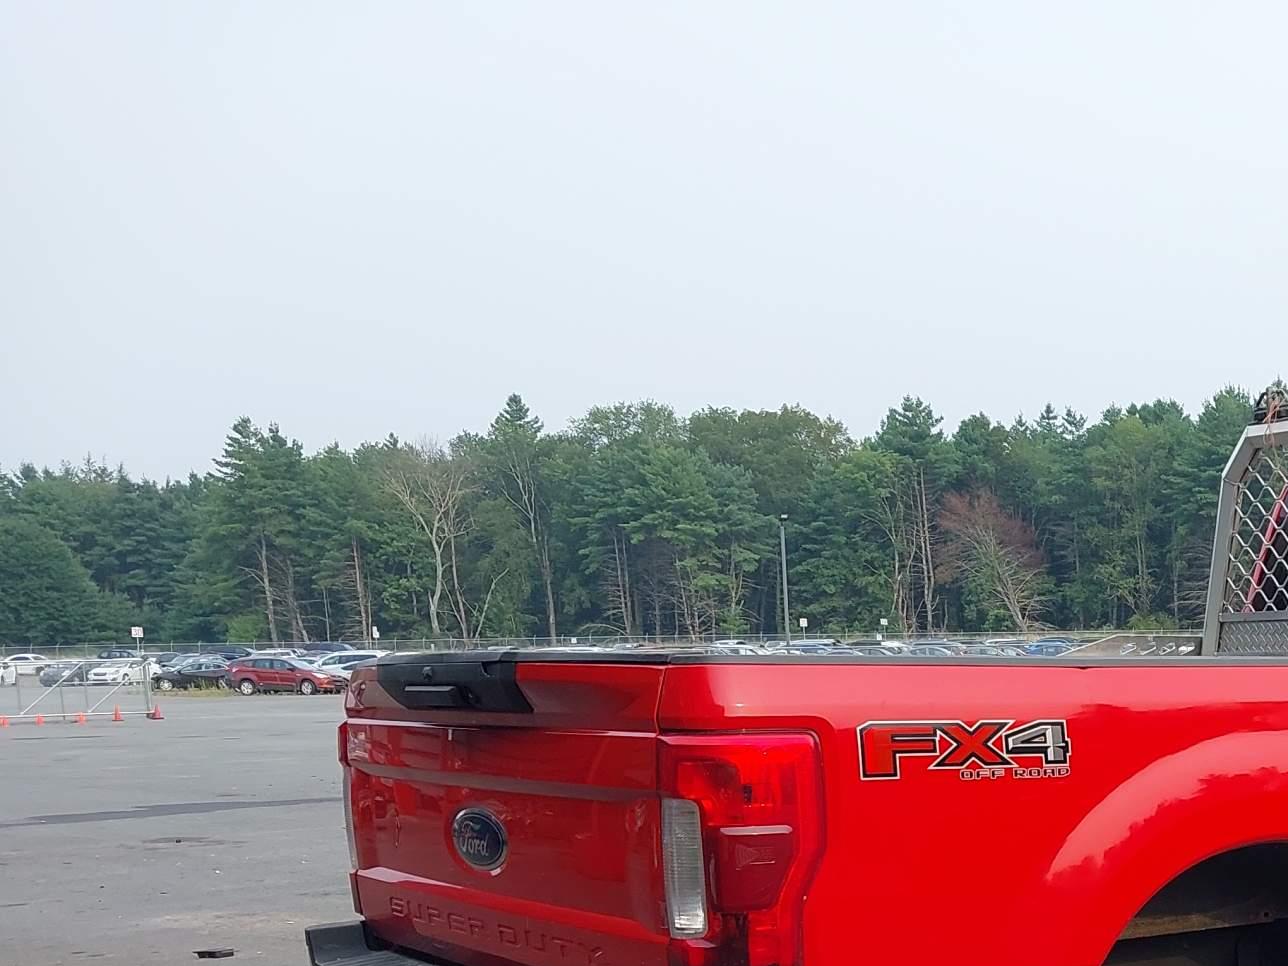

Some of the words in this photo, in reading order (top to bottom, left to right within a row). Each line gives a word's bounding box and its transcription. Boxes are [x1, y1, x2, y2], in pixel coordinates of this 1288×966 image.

[856, 719, 1071, 780] FX4
[960, 768, 1005, 780] OFF
[1012, 767, 1071, 779] ROAD
[388, 895, 485, 937] SUPER
[497, 923, 611, 966] DUTY
